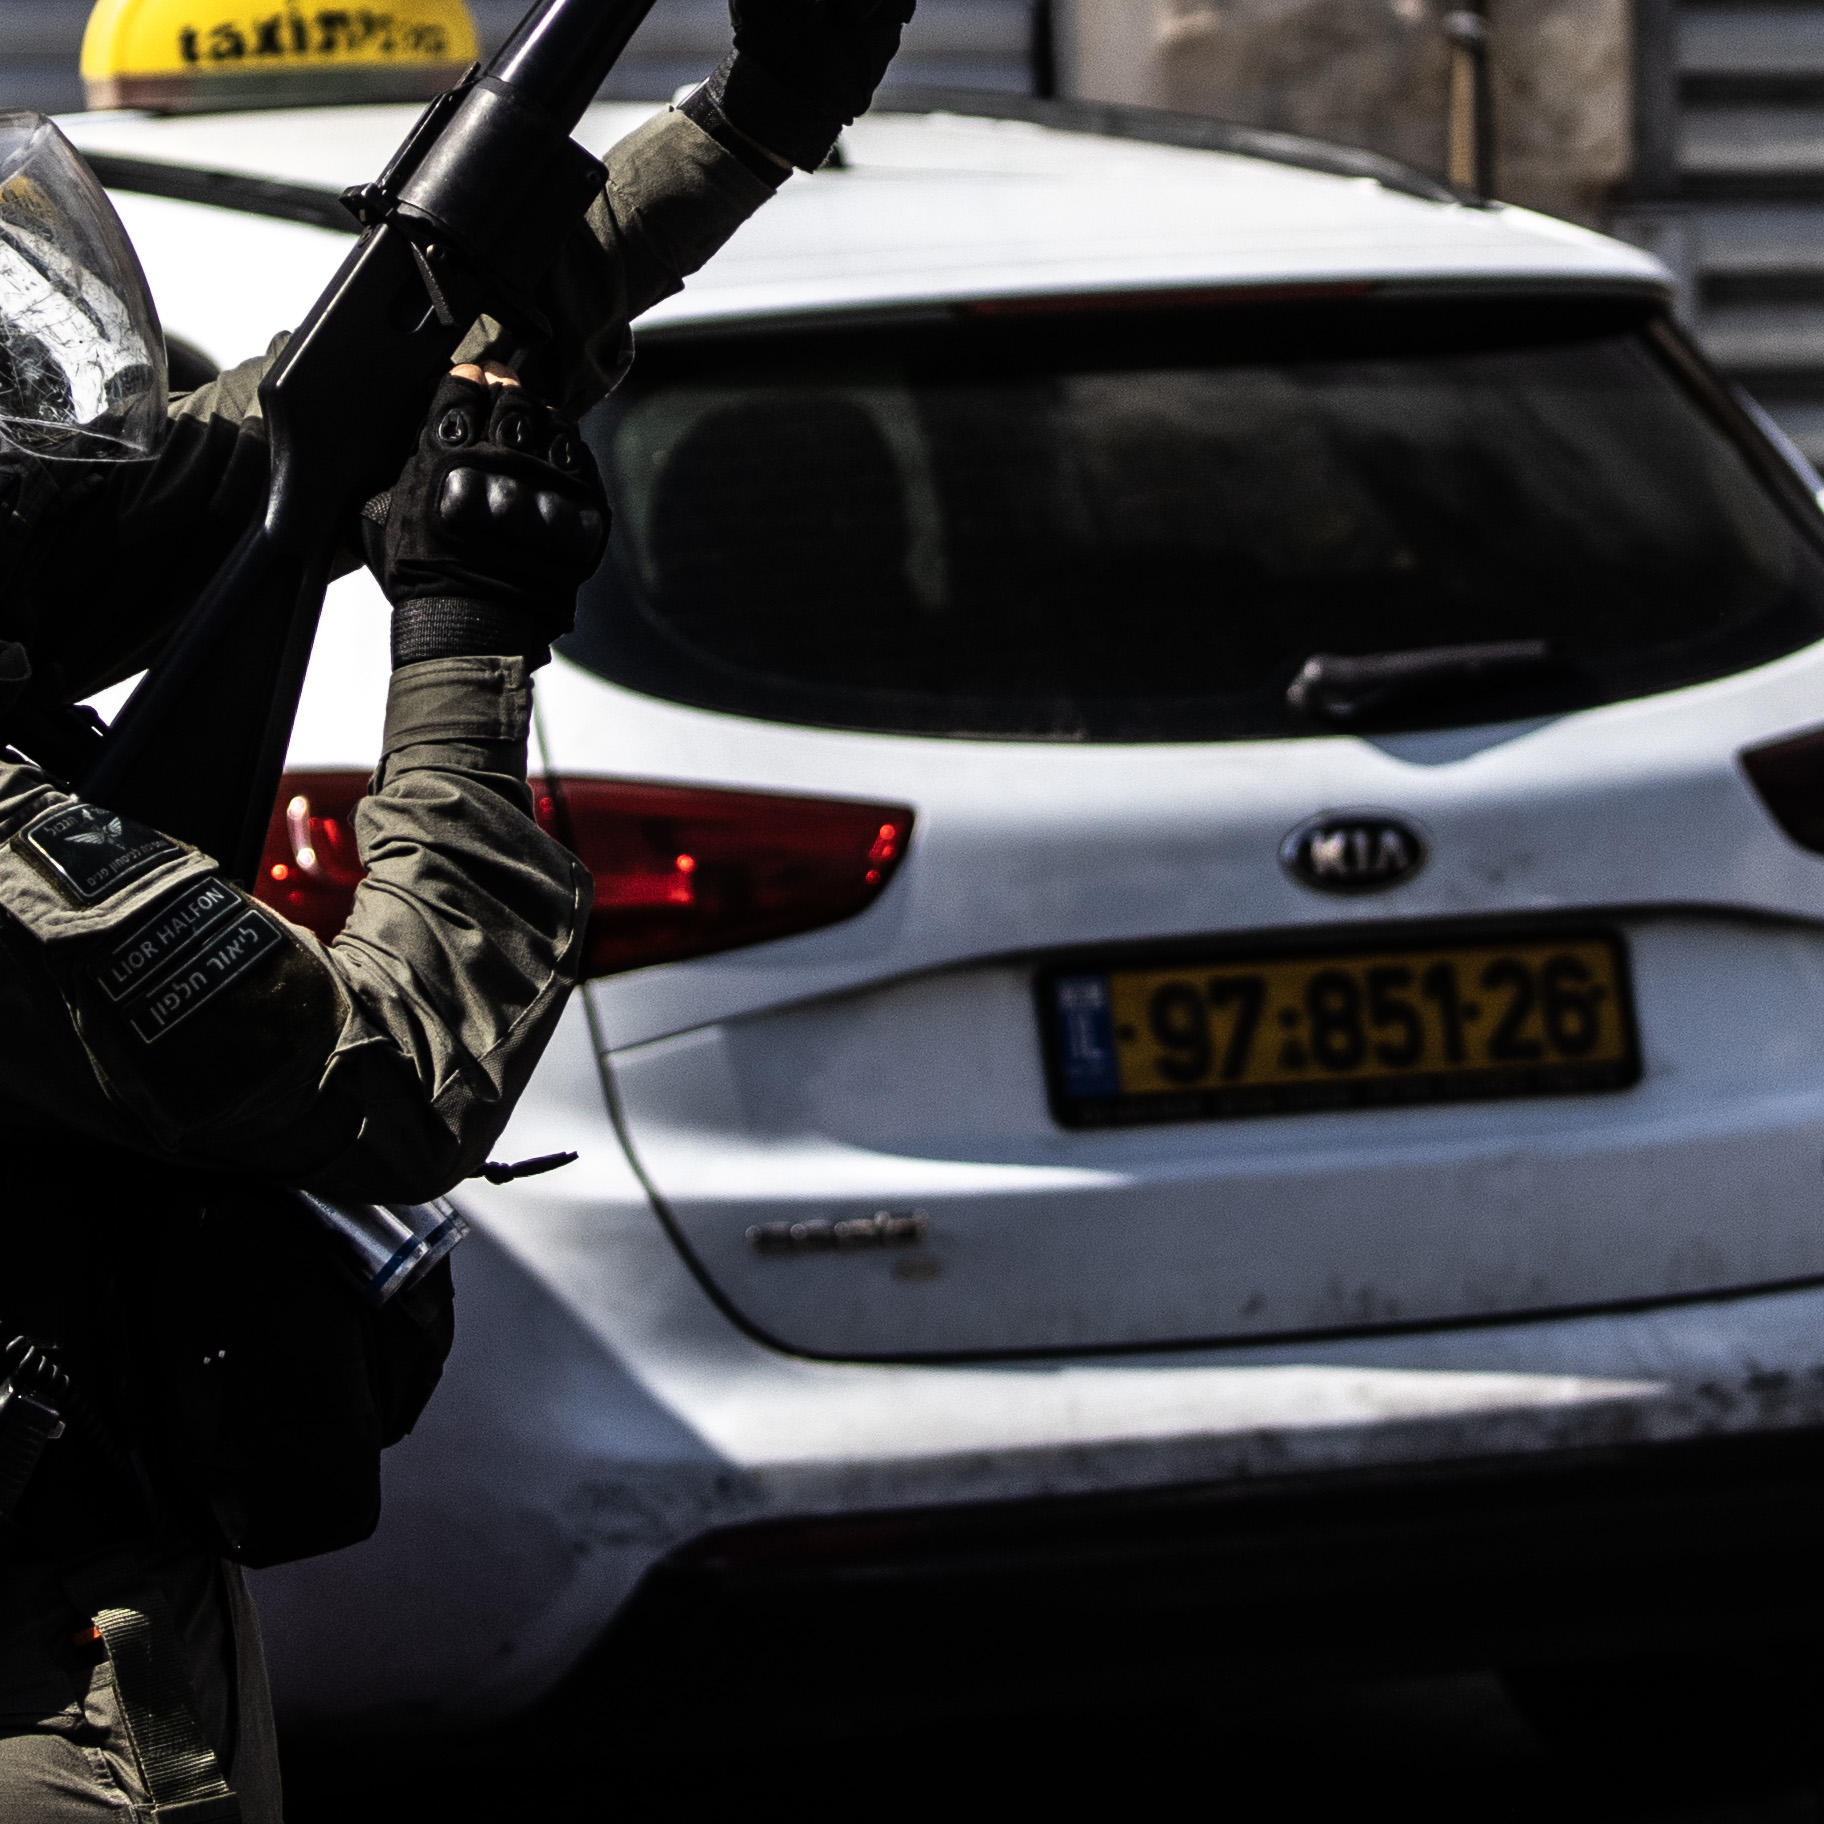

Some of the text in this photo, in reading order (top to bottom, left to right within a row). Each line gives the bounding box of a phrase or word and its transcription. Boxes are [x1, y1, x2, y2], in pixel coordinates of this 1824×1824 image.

[1310, 830, 1409, 874] KIA
[110, 886, 226, 983] LIOR HALFON
[149, 926, 260, 1026] ליאור חלפון
